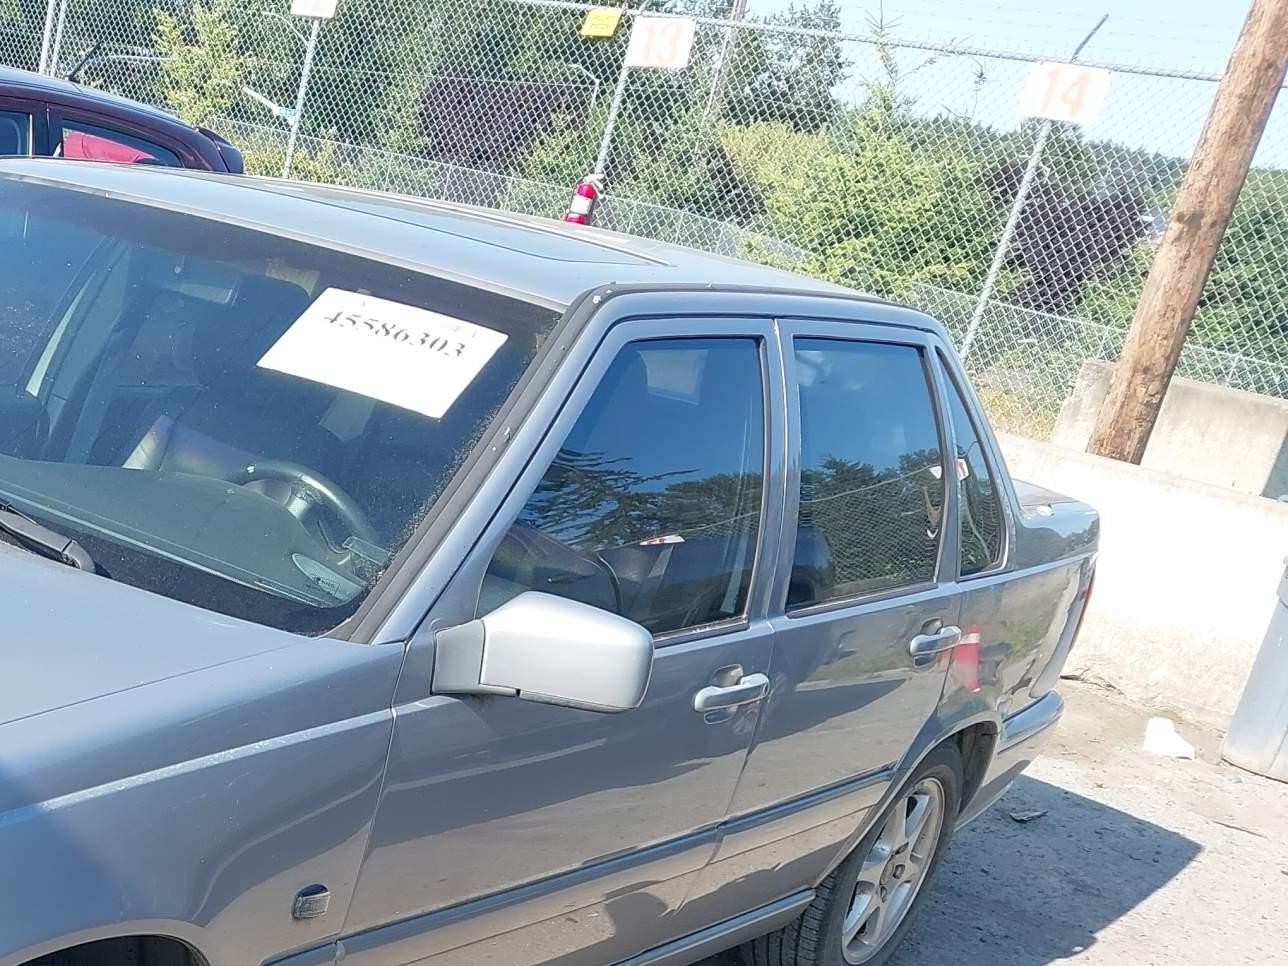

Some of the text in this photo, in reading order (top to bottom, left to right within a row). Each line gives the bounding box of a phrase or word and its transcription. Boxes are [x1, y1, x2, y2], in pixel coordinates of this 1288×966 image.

[642, 21, 681, 64] 13
[1039, 65, 1090, 117] 14
[323, 311, 466, 357] 45586303
